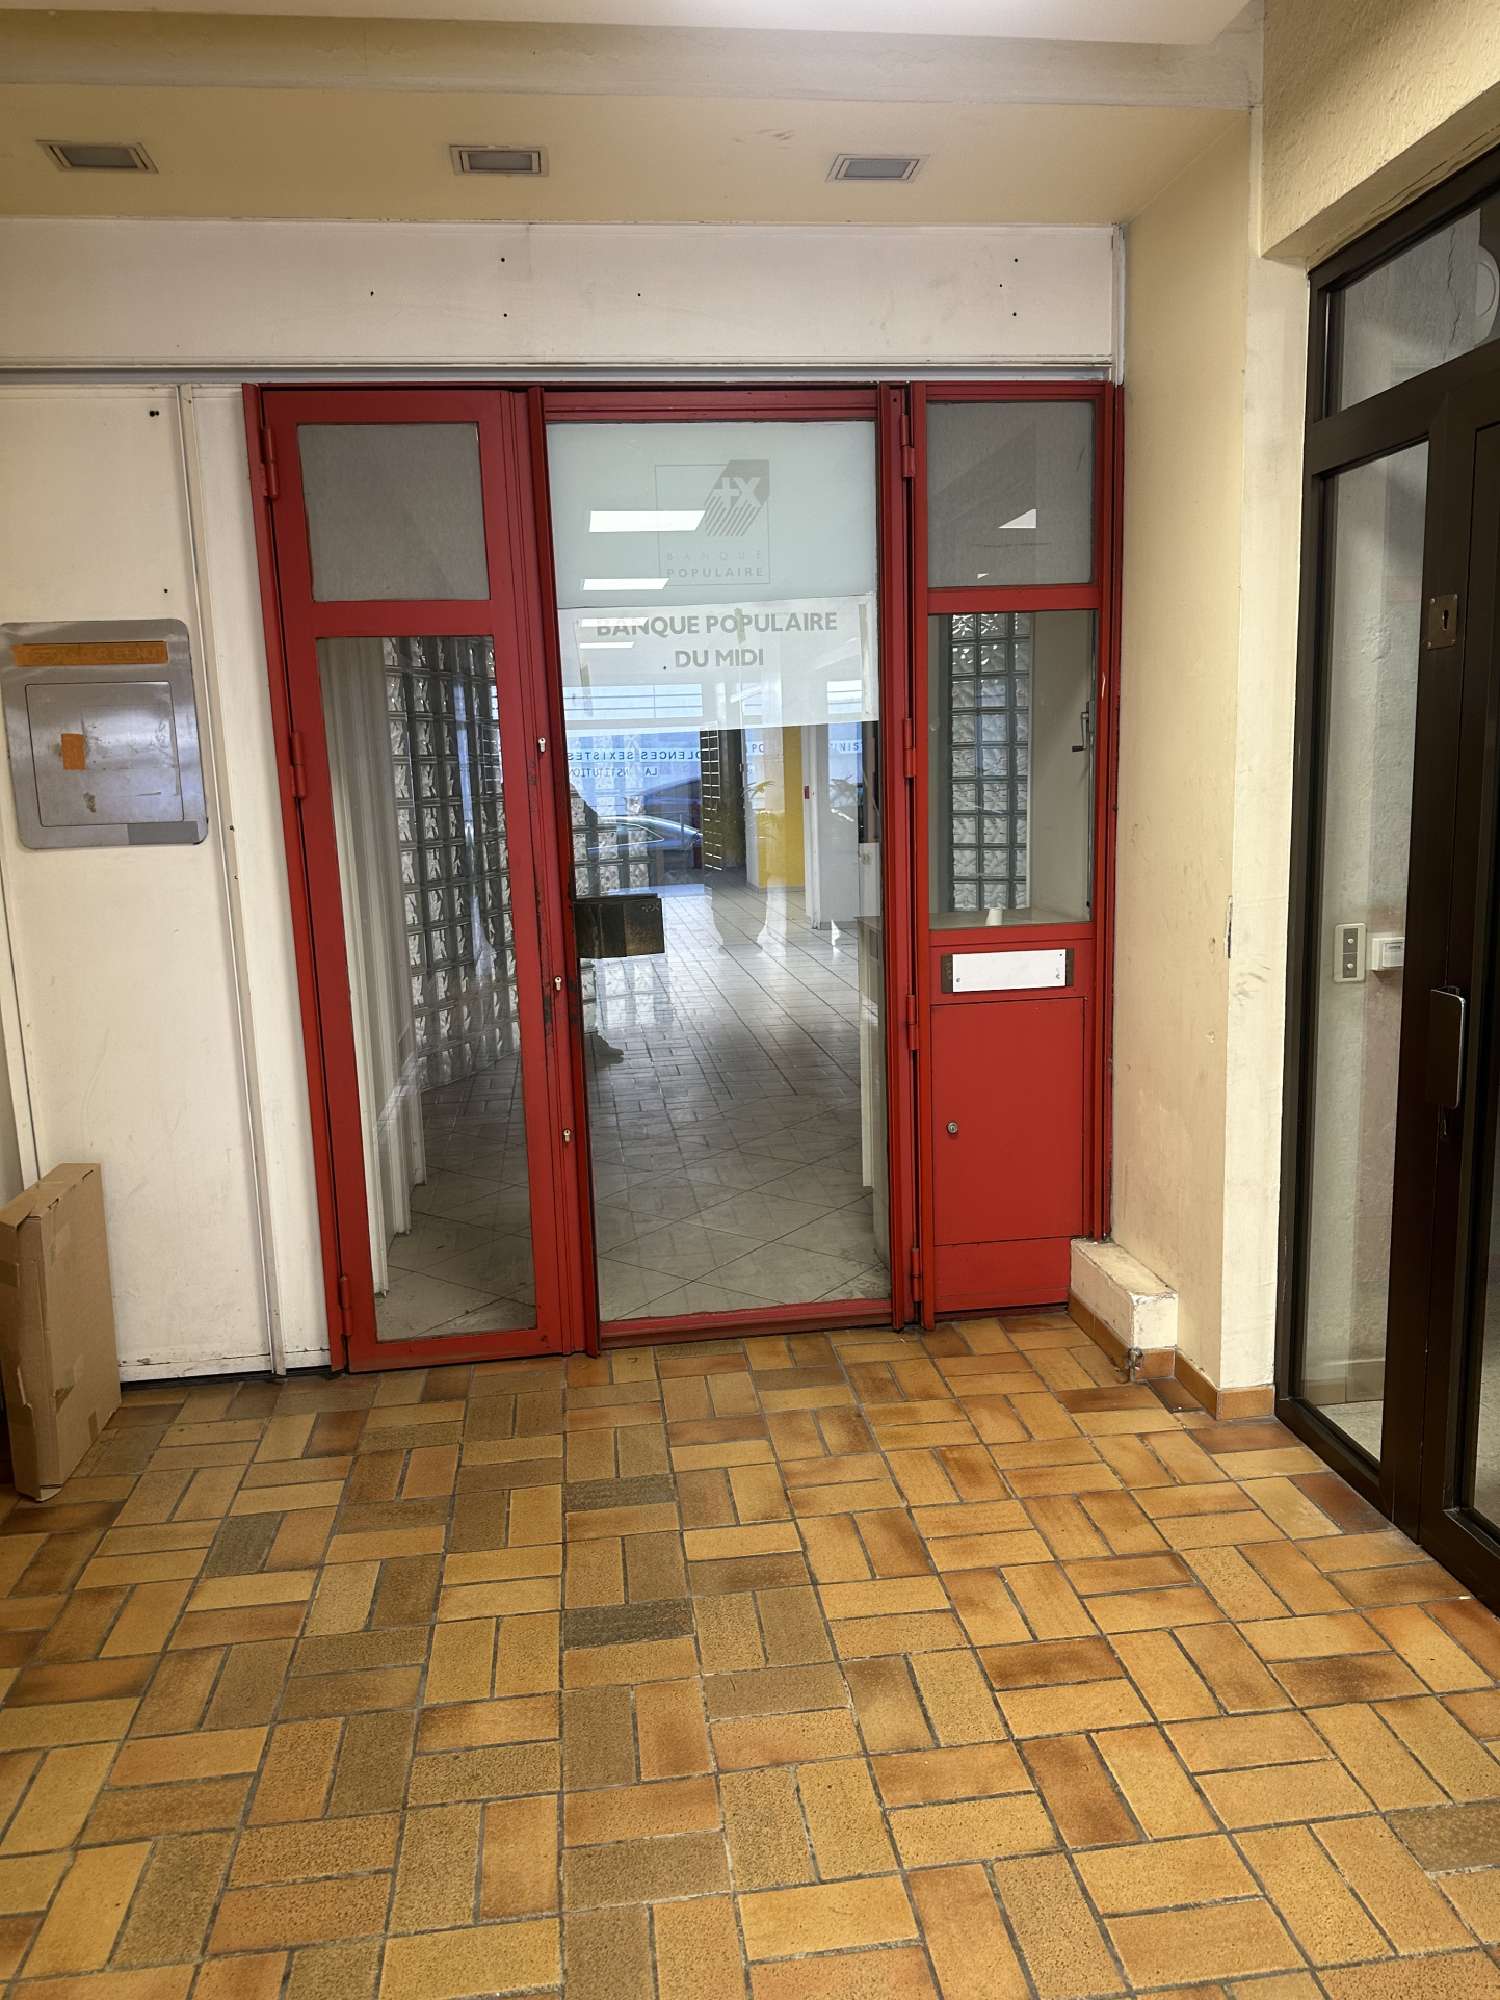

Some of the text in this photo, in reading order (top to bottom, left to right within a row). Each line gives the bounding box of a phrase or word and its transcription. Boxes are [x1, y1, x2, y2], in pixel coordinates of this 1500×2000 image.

[666, 550, 761, 560] BANQUE
[666, 567, 764, 578] POPULAIRE
[596, 611, 837, 638] BANQUE POPULAIRE
[675, 647, 764, 668] DU MIDI
